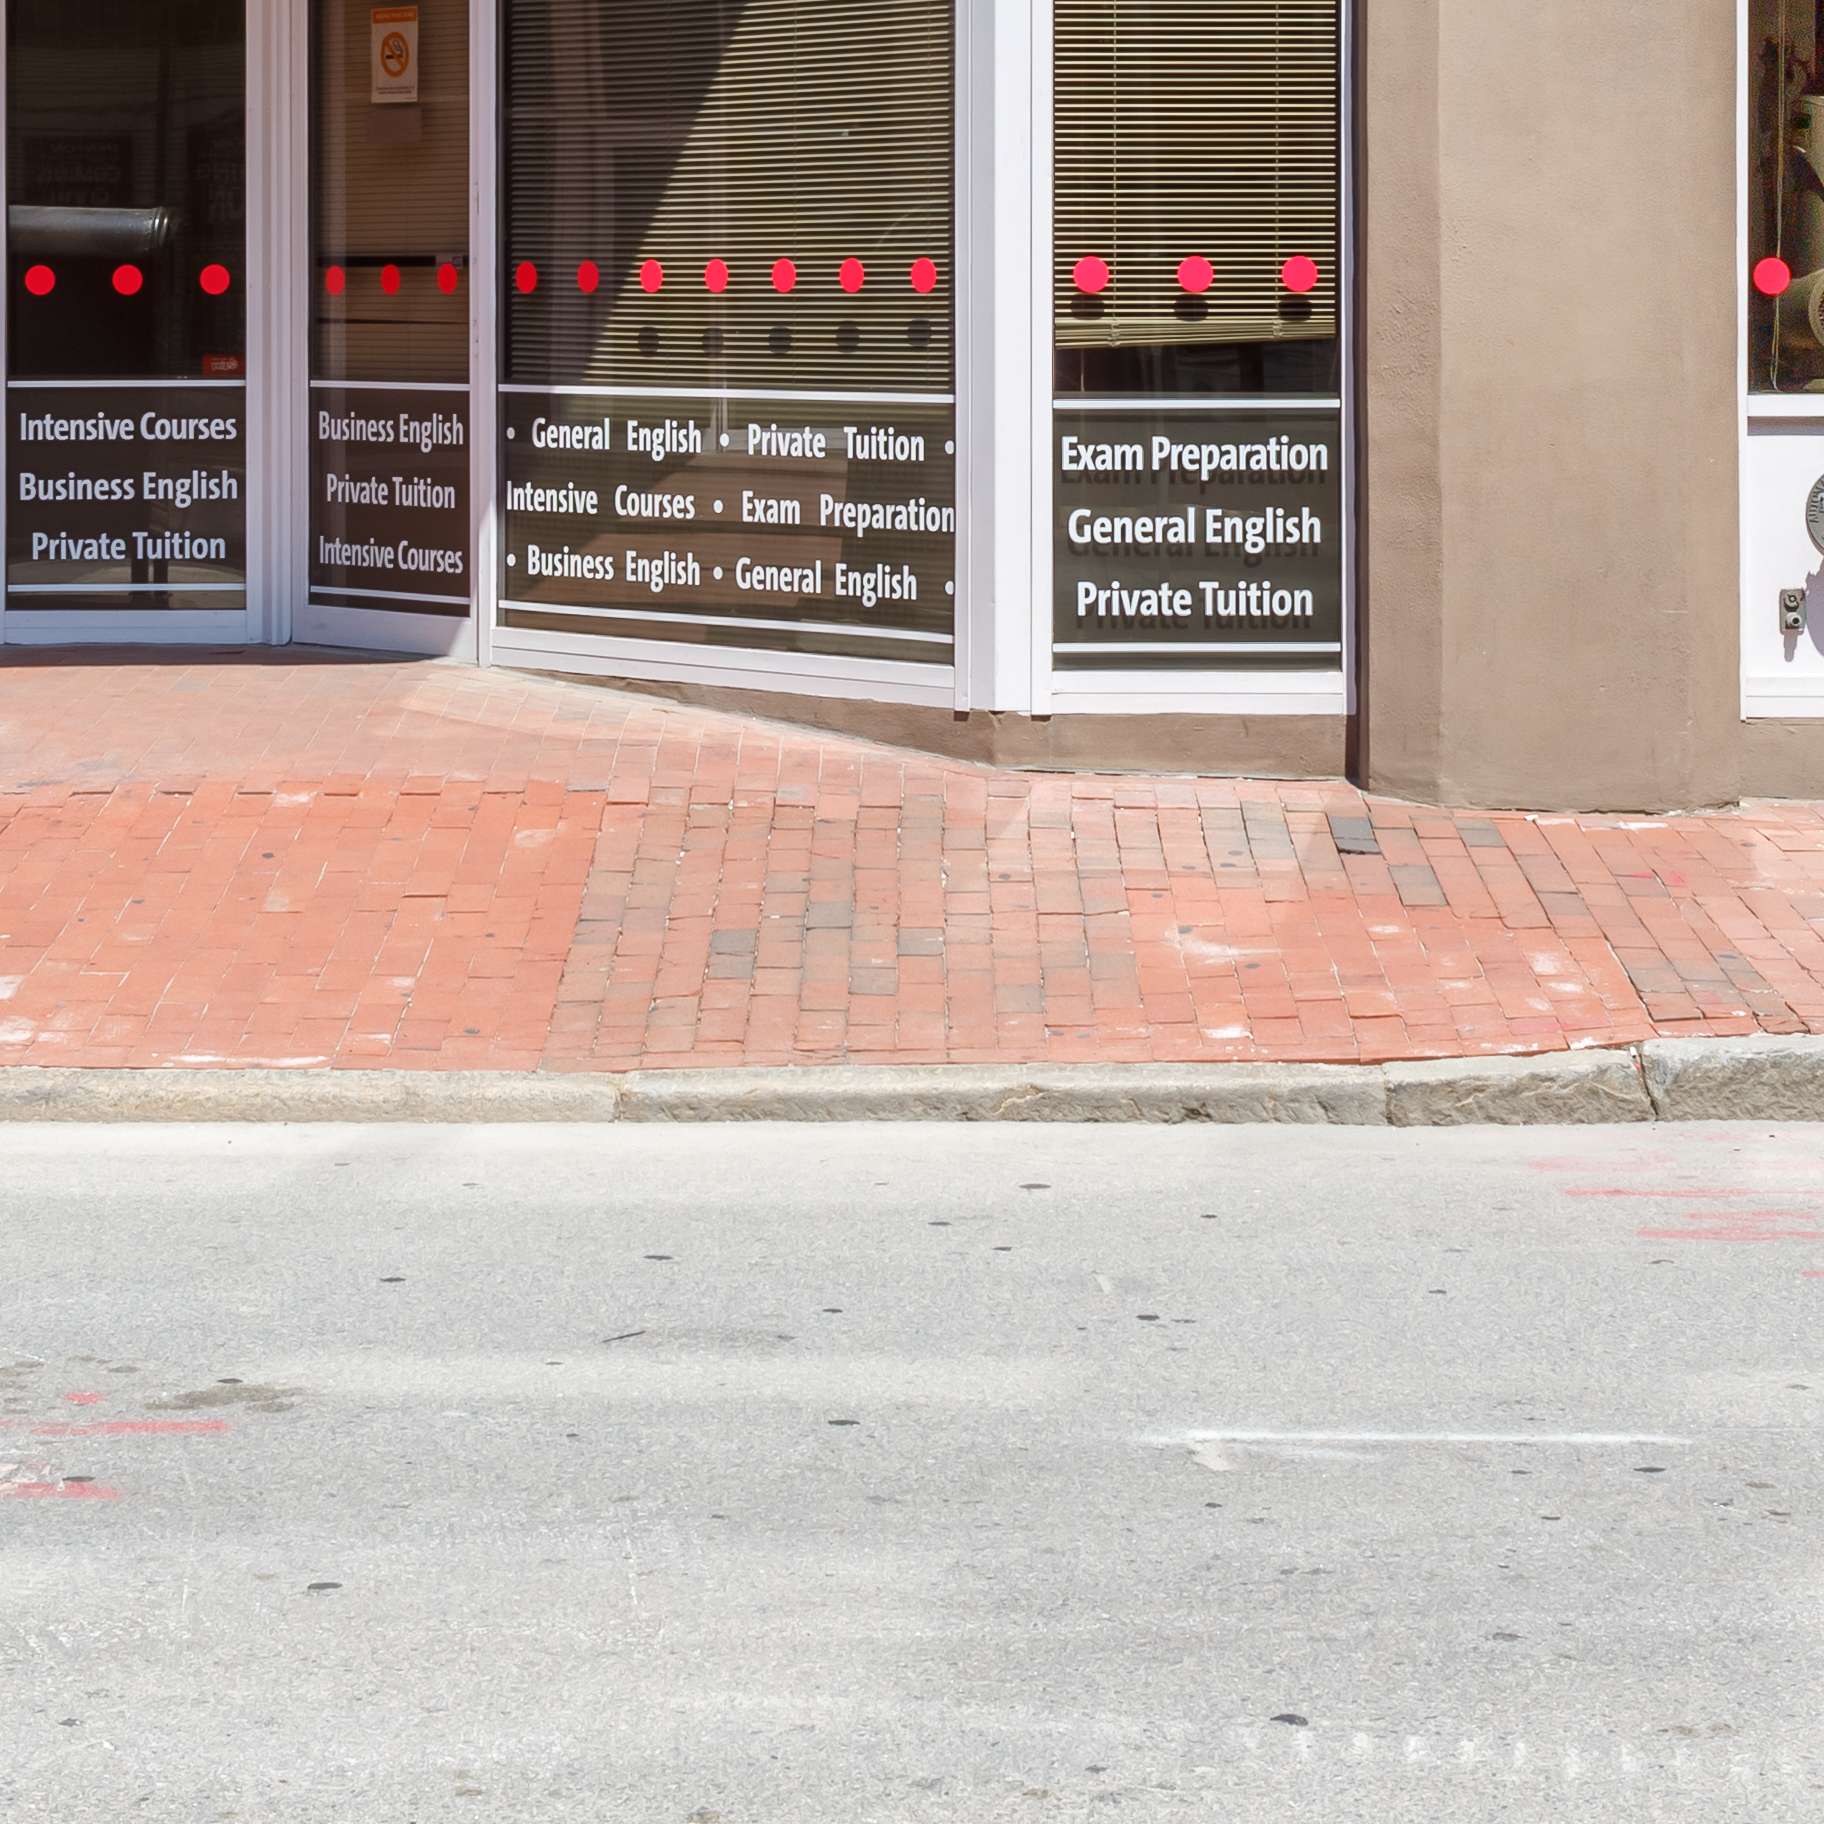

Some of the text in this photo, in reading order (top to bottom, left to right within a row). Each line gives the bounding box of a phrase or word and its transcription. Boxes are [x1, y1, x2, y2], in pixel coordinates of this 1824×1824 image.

[20, 411, 237, 441] Intensive Courses
[319, 410, 464, 453] Business English
[532, 417, 925, 462] General English Private Tuition
[1061, 434, 1328, 481] Exam Preparation
[19, 469, 238, 509] Business English
[326, 473, 456, 509] Private Tuition
[506, 480, 955, 538] Intensive Courses Exam Preparation
[32, 530, 226, 561] Private Tuition
[1068, 506, 1322, 554] General English
[319, 535, 464, 574] Intensive Courses
[527, 544, 917, 608] Business English General English
[1077, 580, 1313, 617] Private Tuition
